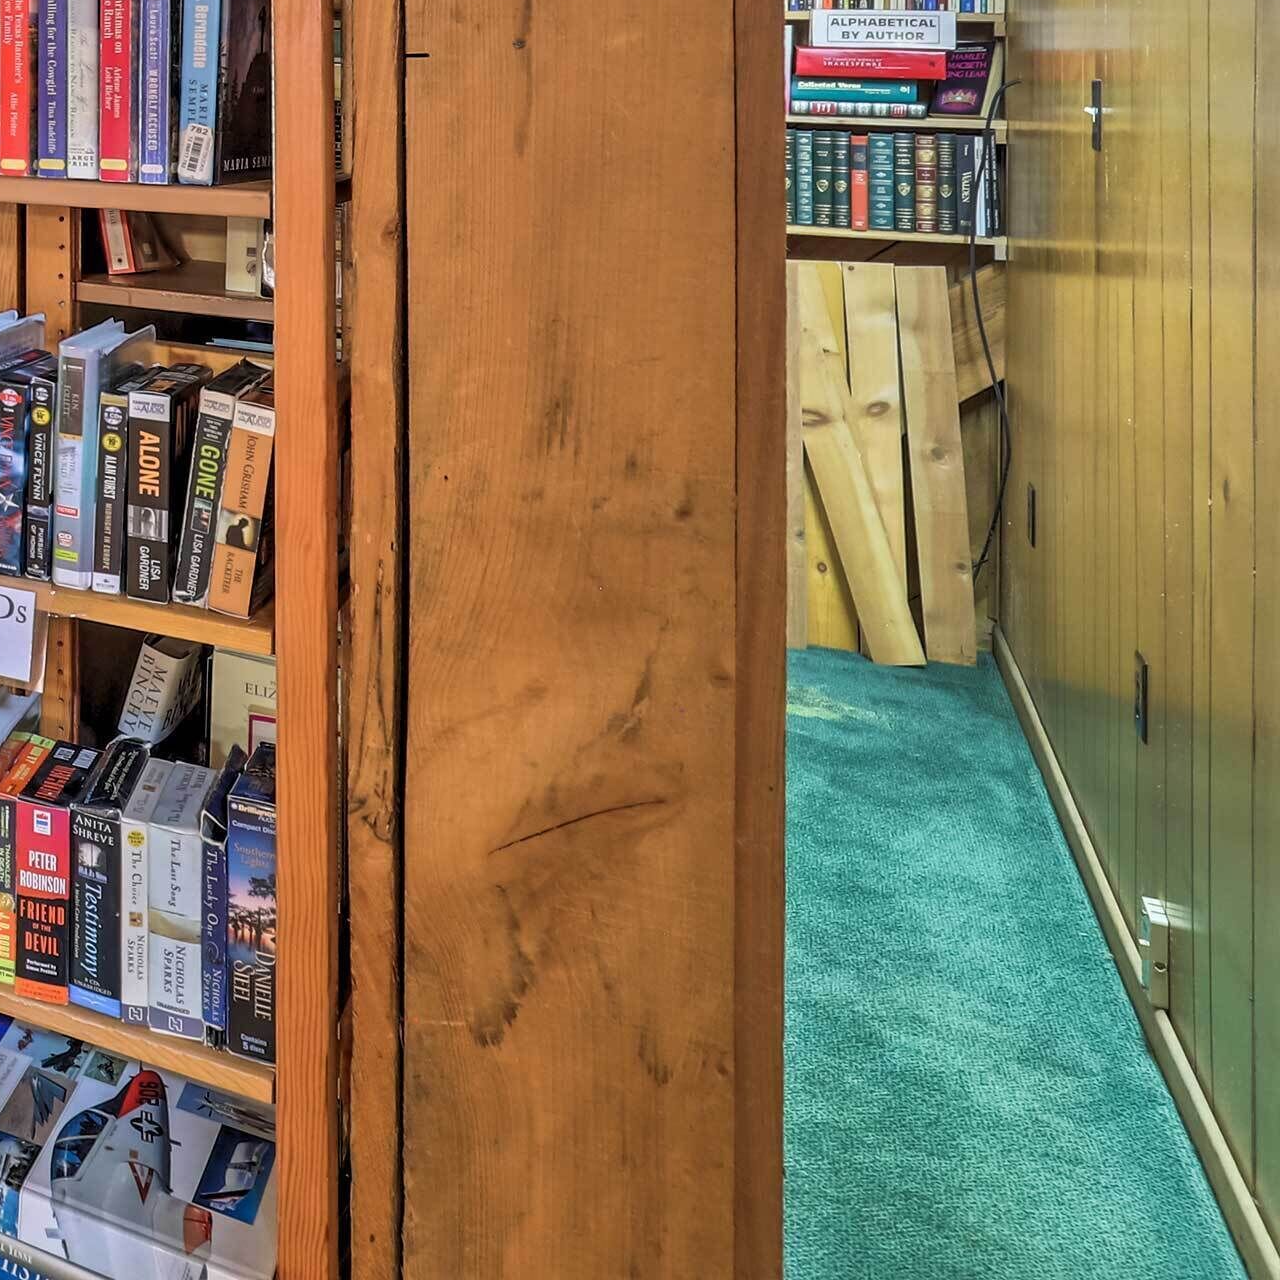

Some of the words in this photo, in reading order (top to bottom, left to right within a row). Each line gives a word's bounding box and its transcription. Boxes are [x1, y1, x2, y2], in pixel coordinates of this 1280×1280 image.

[830, 17, 937, 28] ALPHABETICAL
[841, 30, 861, 41] BY
[865, 30, 925, 41] AUTHOR
[952, 52, 986, 61] HAMLET
[139, 430, 161, 497] ALONE
[139, 546, 150, 591] GARDNER
[150, 558, 161, 582] LISA
[124, 653, 155, 732] BINCHY
[139, 665, 168, 733] MAEVE
[72, 824, 114, 847] SHREVE
[75, 815, 112, 834] ANITA
[28, 850, 57, 871] PETER
[20, 870, 66, 895] ROBINSON
[20, 899, 65, 925] FRIEND
[79, 882, 102, 980] Testimony
[24, 932, 60, 957] DEVIL
